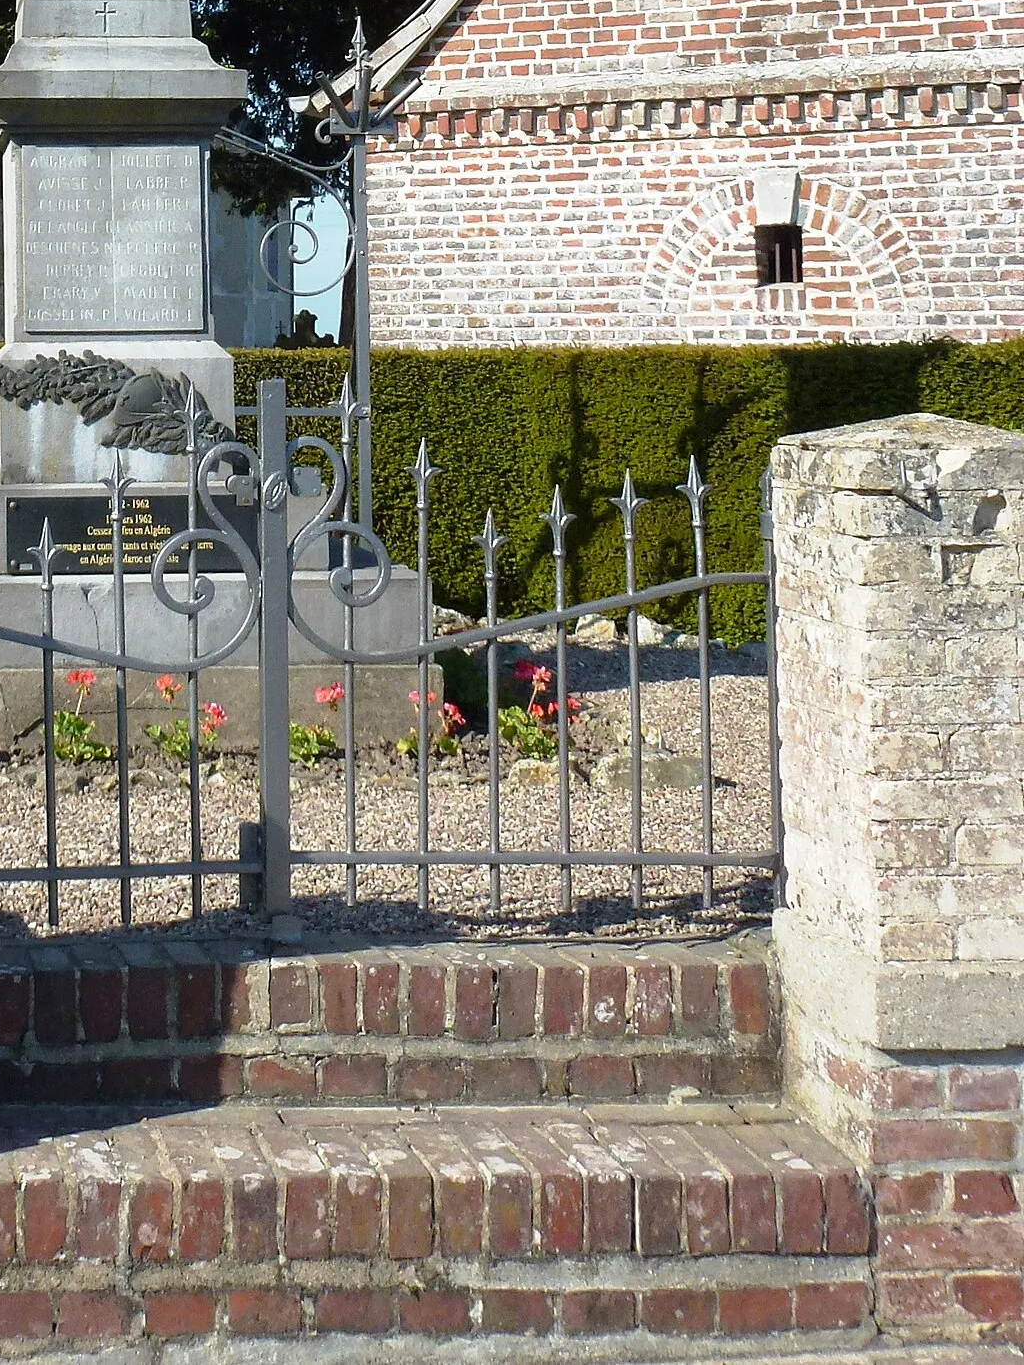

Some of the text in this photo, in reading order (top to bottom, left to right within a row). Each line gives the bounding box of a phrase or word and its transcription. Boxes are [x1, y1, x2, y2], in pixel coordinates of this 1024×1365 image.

[101, 308, 110, 321] P
[108, 499, 126, 509] 12
[132, 499, 150, 509] 1962
[135, 514, 153, 524] 1962
[134, 527, 143, 535] en
[144, 524, 171, 537] Algérie
[82, 543, 96, 551] aux
[141, 541, 148, 550] et
[80, 556, 89, 564] en
[144, 554, 152, 564] et
